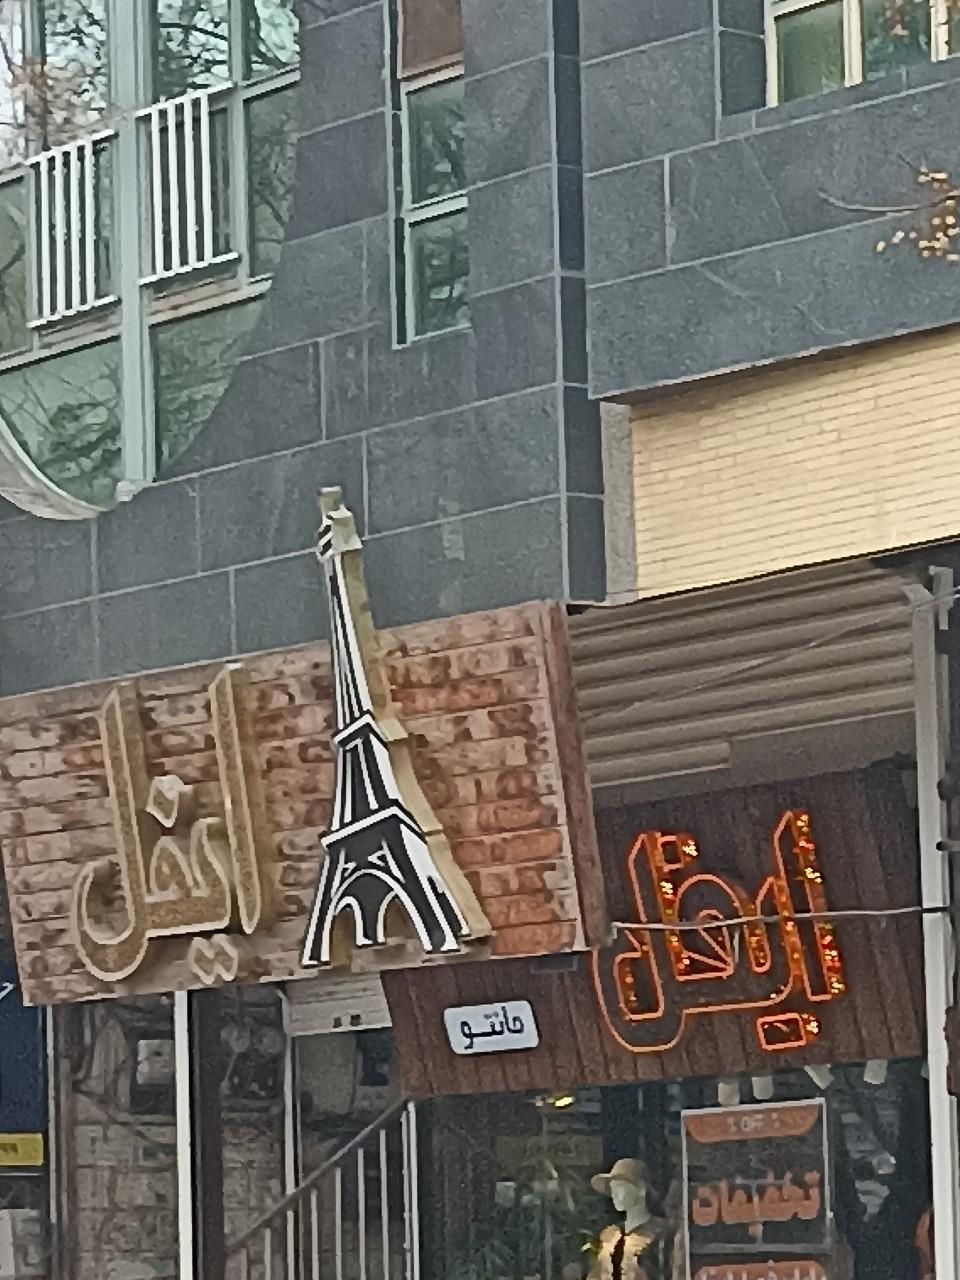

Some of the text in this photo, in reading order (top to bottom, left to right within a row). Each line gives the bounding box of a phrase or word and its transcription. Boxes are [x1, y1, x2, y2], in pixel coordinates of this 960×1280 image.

[71, 660, 264, 984] ایفل
[591, 808, 846, 1053] ایفل
[460, 1005, 525, 1050] مانتو
